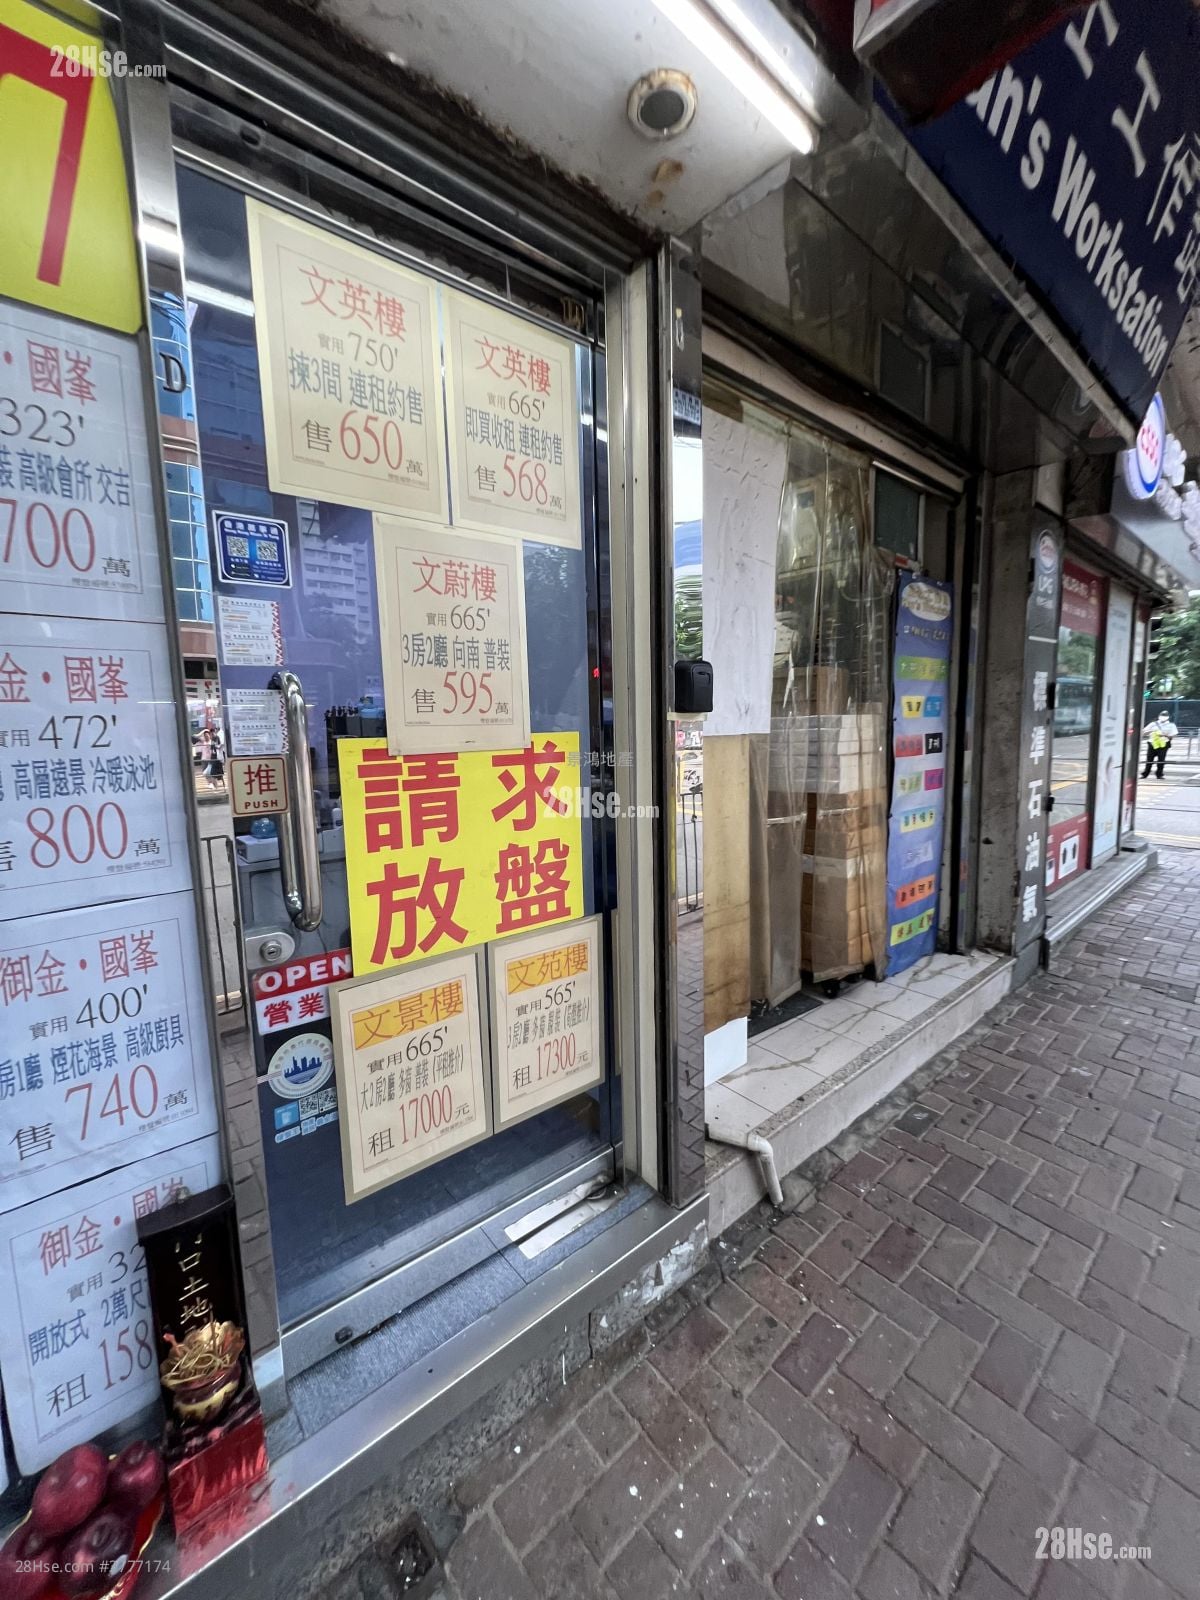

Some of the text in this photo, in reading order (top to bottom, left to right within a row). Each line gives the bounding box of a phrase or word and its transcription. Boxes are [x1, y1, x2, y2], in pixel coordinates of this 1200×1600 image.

[1051, 133, 1170, 378] Workstation
[299, 265, 406, 342] 文英樓
[159, 352, 187, 393] D
[318, 332, 398, 372] 實用 750'
[474, 335, 551, 396] 文英樓
[349, 368, 424, 426] 連租約售
[508, 390, 545, 422] 665'
[301, 409, 423, 477] 售 650 萬
[465, 406, 563, 467] 即買收租 連租約售
[16, 447, 93, 503] 高級會所
[95, 463, 131, 507] 交吉
[474, 454, 562, 510] 售 568 萬
[101, 556, 131, 578] 萬
[412, 556, 497, 602] 文蔚樓
[426, 604, 490, 632] 實用 665'
[402, 631, 511, 671] 3房2廳 向南 普裝
[411, 671, 509, 715] 售 595 萬
[38, 714, 117, 750] 472'
[11, 754, 158, 801] 高層遠景 冷暖泳池
[243, 763, 278, 796] 推
[244, 799, 279, 810] PUSH
[26, 801, 129, 869] 800
[133, 838, 161, 857] 萬
[257, 954, 351, 993] OPEN
[507, 943, 588, 995] 文苑樓
[29, 983, 149, 1041] 實用 400'
[263, 991, 325, 1028] 營業
[352, 979, 464, 1050] 文景樓
[515, 981, 576, 1018] 實用 565'
[50, 1031, 119, 1085] 煙花海景
[123, 1014, 185, 1061] 高級廚具
[366, 1051, 402, 1075] 實用
[406, 1025, 449, 1062] 665'
[512, 1064, 532, 1090] 租
[536, 1032, 576, 1081] 17300
[577, 1050, 589, 1064] 元
[8, 1122, 57, 1161] 售
[64, 1064, 158, 1141] 740
[163, 1088, 188, 1111] 萬
[367, 1128, 395, 1157] 租
[400, 1084, 452, 1145] 17000
[454, 1102, 470, 1120] 元
[66, 1271, 104, 1303] 實用
[28, 1309, 90, 1367] 開放式
[46, 1318, 151, 1419] 租 158
